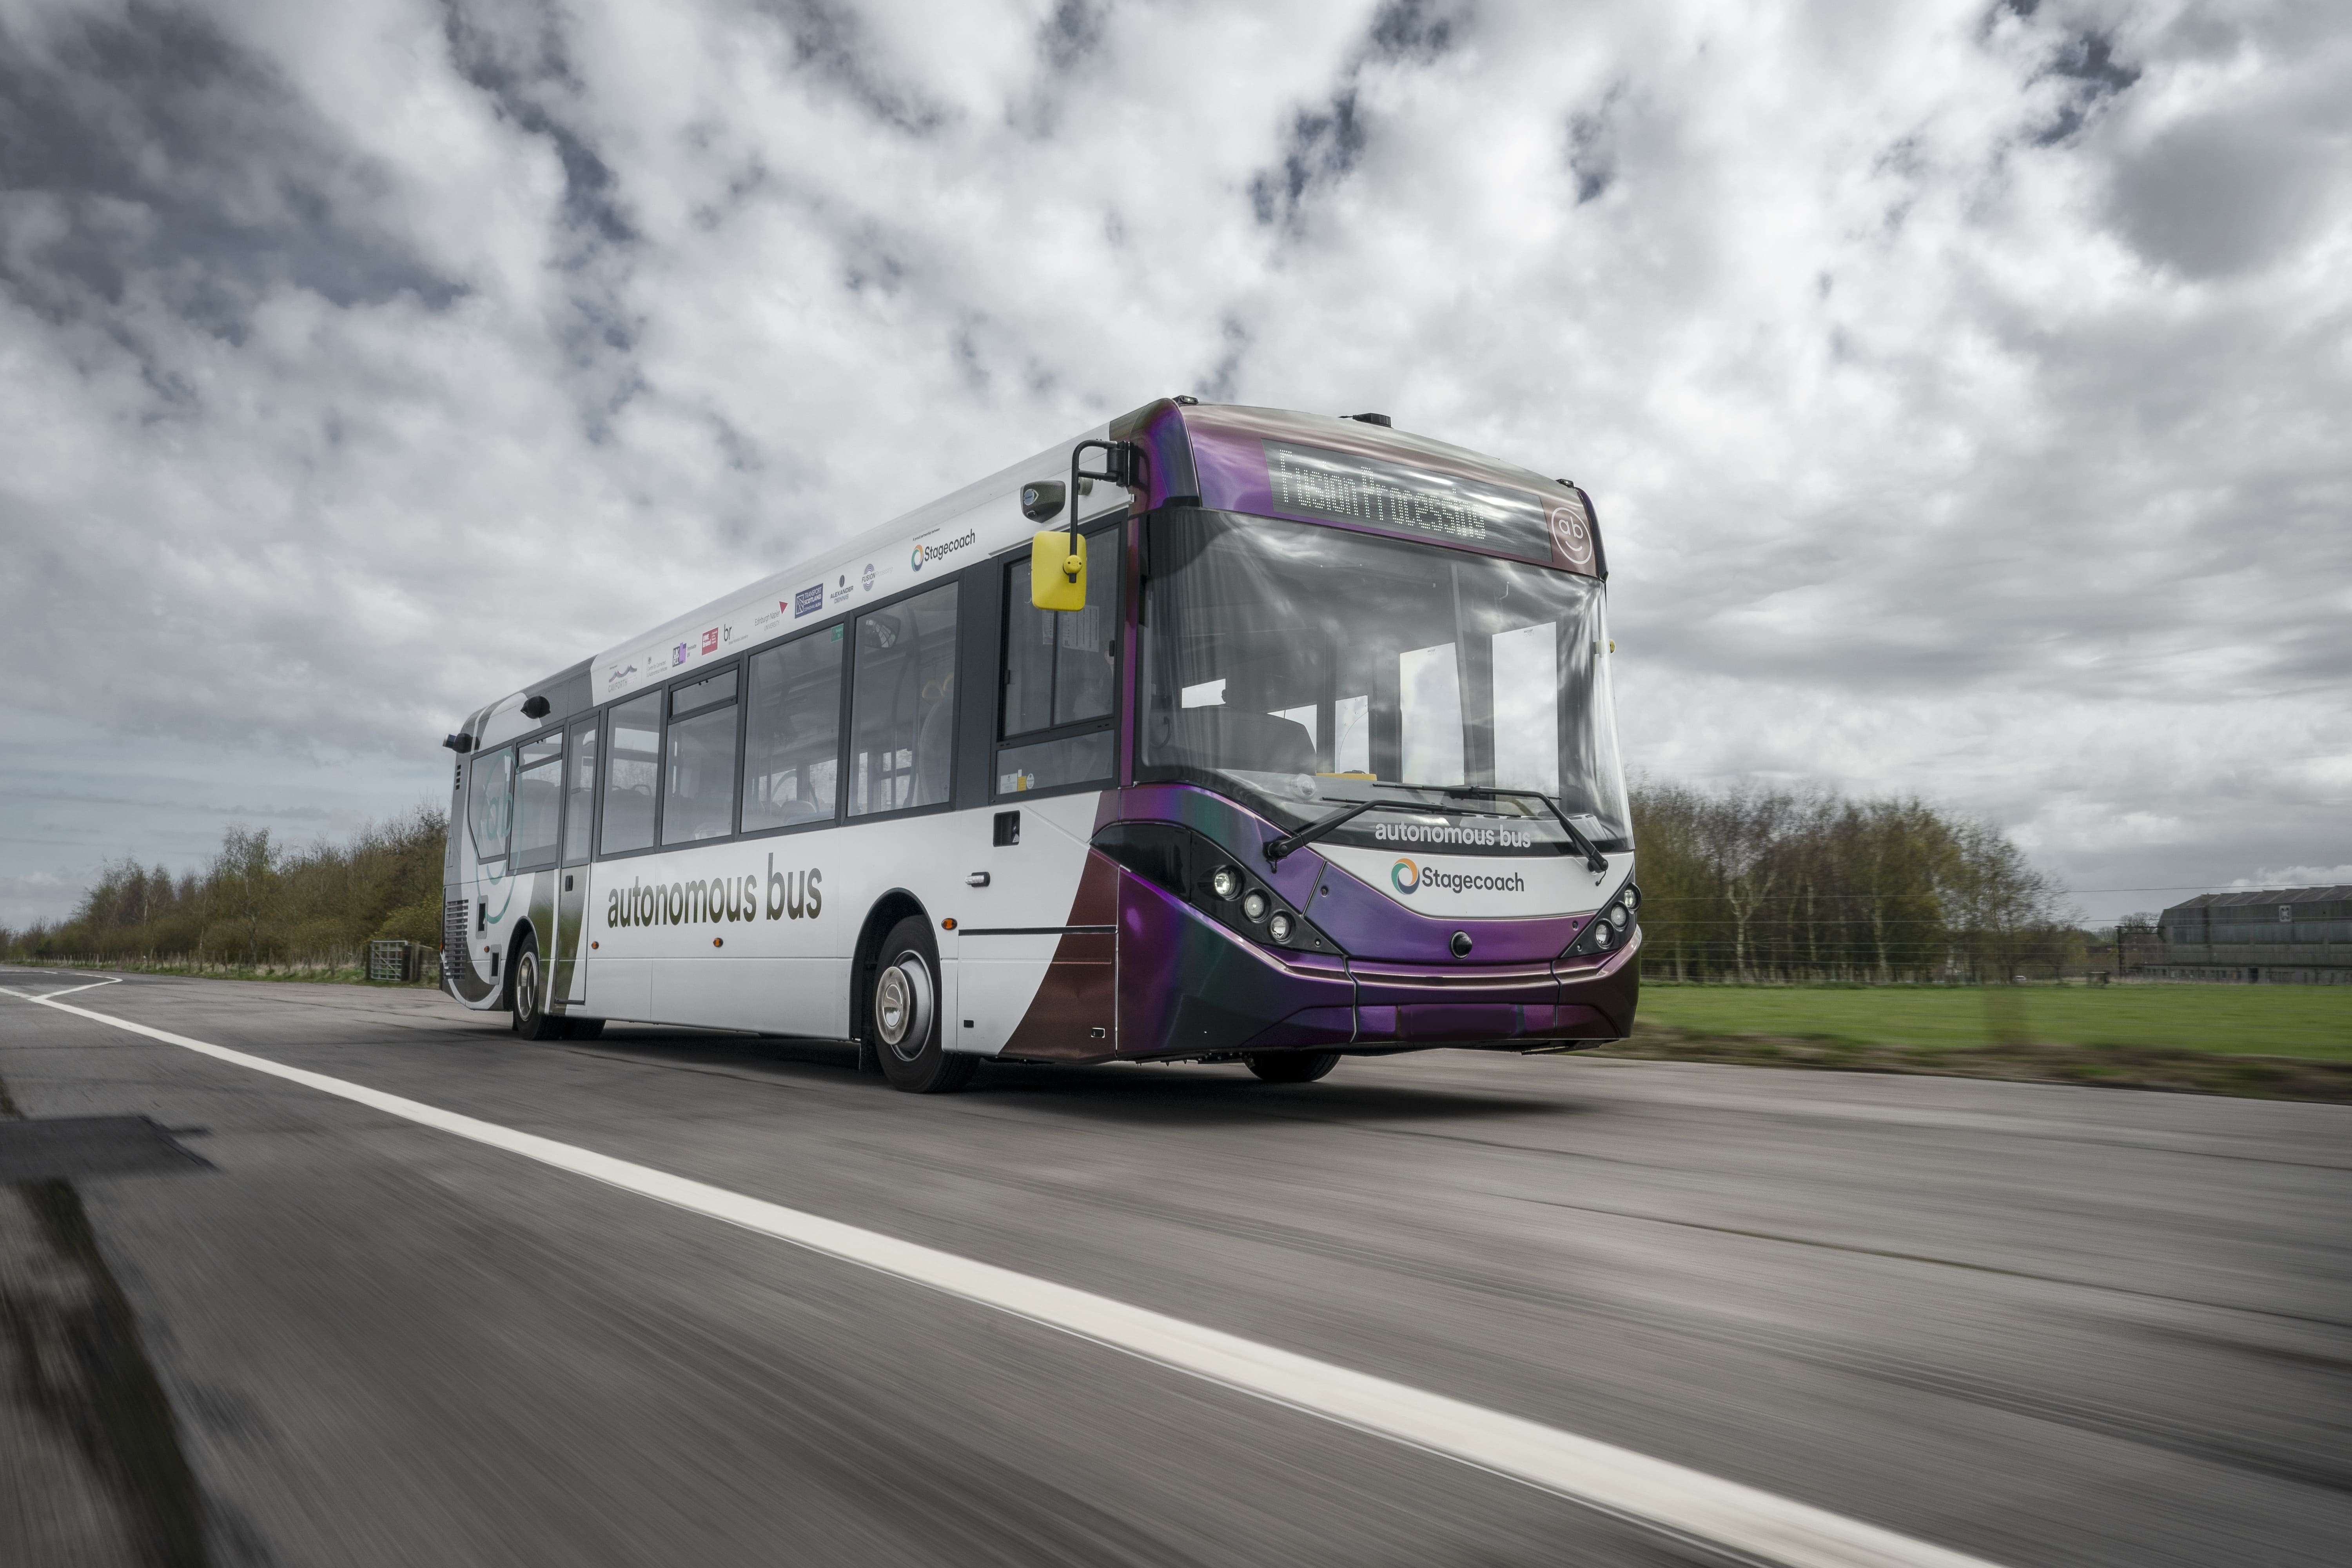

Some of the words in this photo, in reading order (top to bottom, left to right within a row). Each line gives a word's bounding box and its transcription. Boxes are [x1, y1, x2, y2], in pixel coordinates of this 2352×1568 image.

[1279, 450, 1359, 516] Fusion
[1361, 466, 1486, 539] Processing
[924, 528, 975, 562] Stagecoach
[862, 572, 876, 583] FUSION
[804, 586, 822, 599] TRANSPORT
[830, 585, 853, 599] ALEXANDER
[834, 593, 849, 604] DENNIS
[804, 594, 822, 606] SCOTLAND
[755, 613, 769, 626] Edinburgh
[1375, 822, 1495, 846] autonomous
[1500, 825, 1531, 848] bus
[1422, 867, 1524, 894] Stagecoach
[608, 876, 757, 928] autonomous
[766, 852, 822, 920] bus
